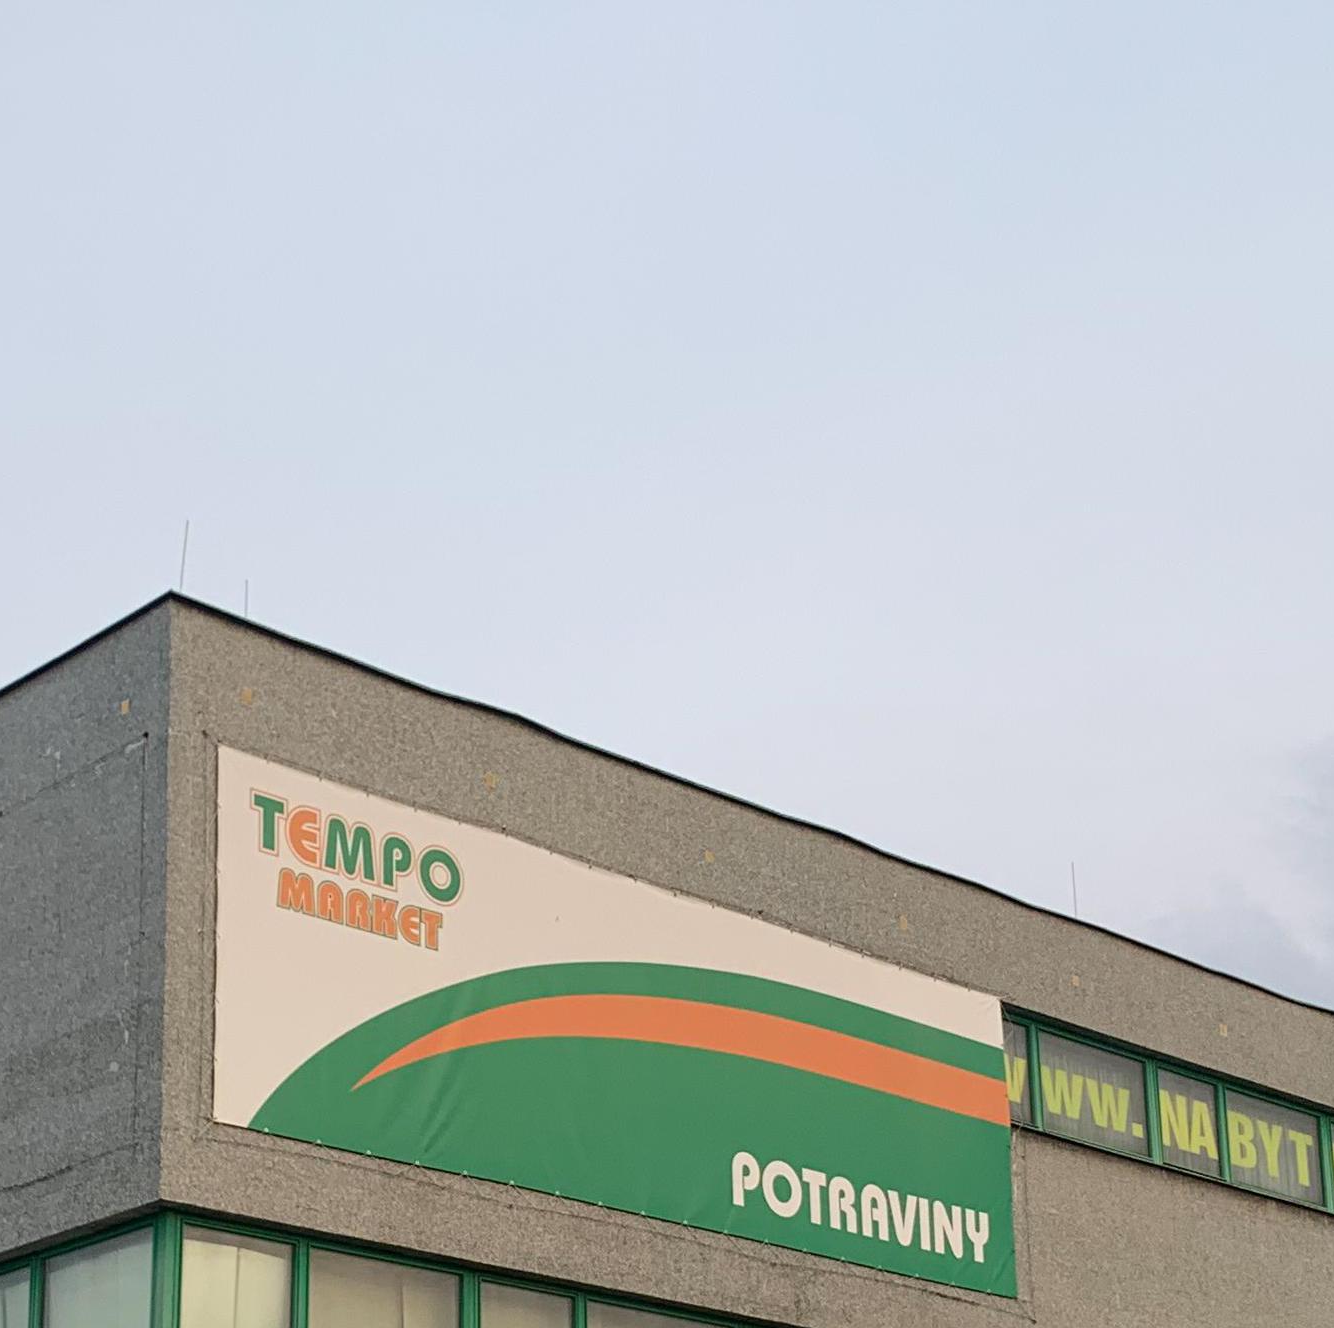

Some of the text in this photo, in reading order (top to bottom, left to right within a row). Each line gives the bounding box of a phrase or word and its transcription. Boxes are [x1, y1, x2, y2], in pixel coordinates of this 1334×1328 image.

[249, 787, 465, 906] TEMPO
[277, 867, 443, 951] MARKET
[733, 1151, 989, 1264] POTRAVINY
